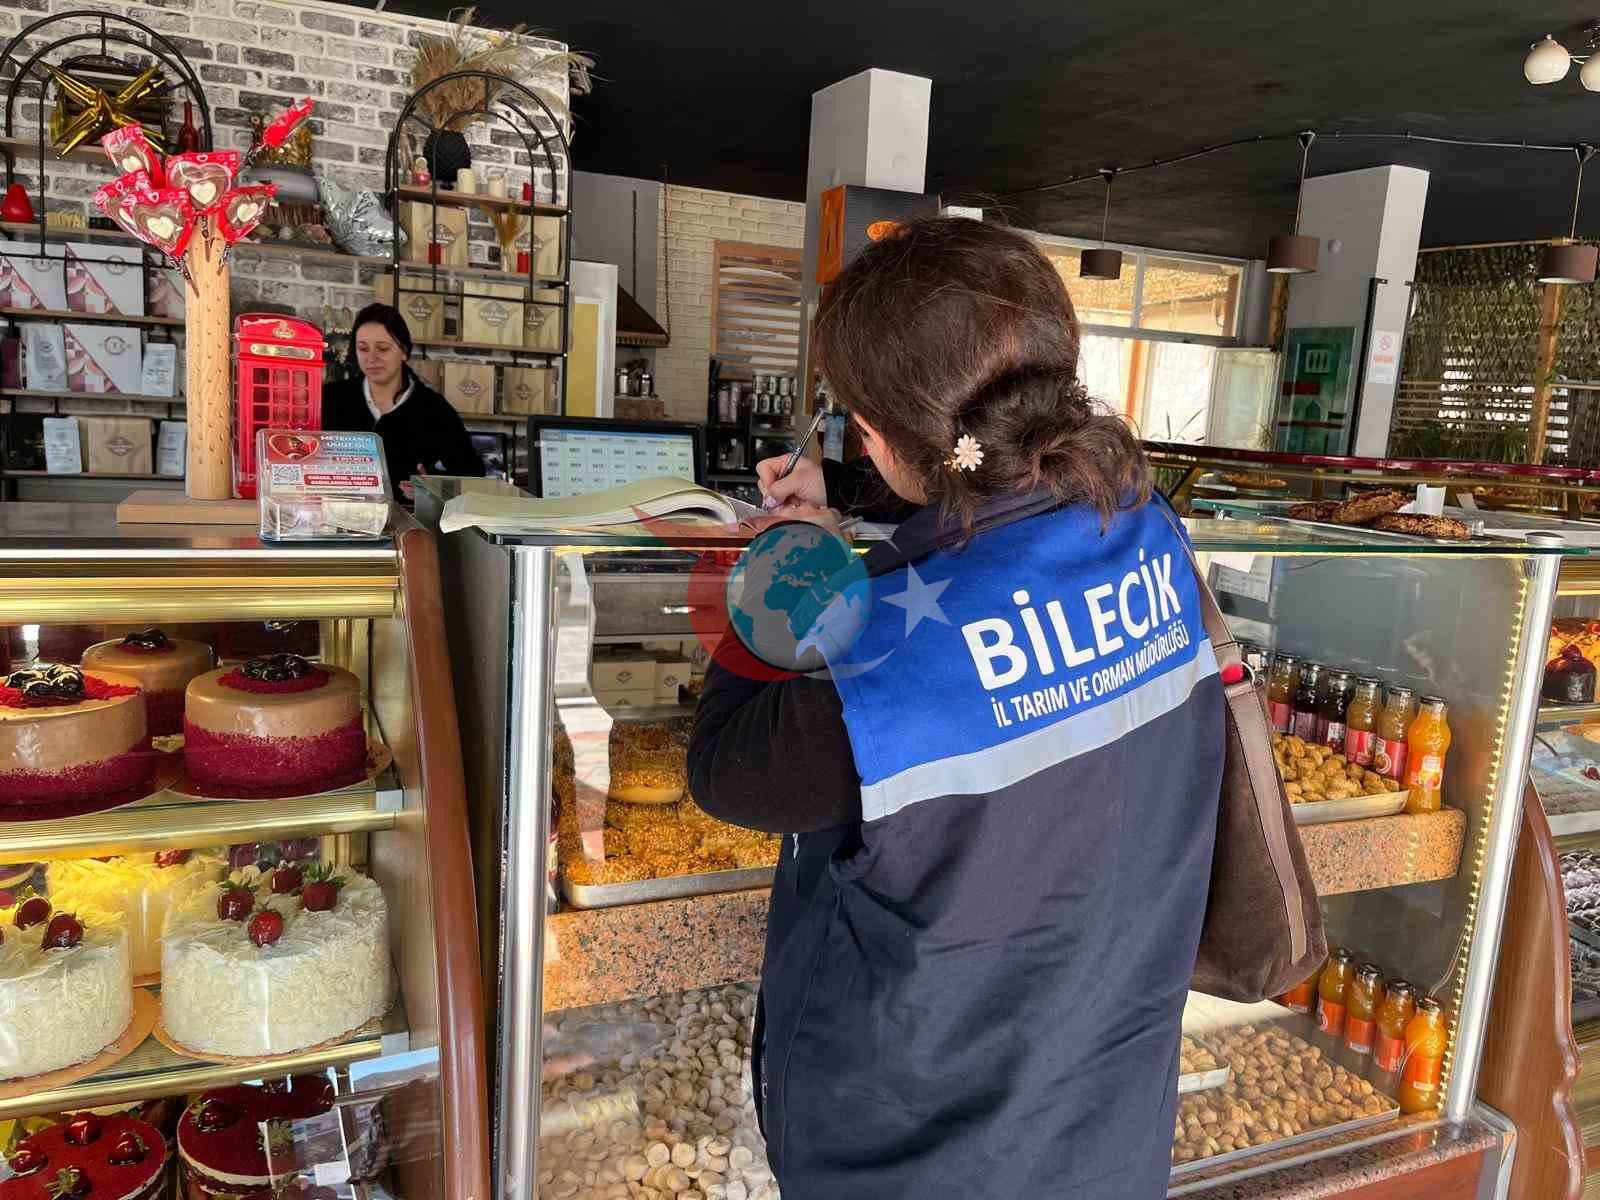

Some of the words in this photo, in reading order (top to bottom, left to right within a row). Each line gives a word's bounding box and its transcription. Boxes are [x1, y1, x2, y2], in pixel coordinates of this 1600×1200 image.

[961, 548, 1182, 691] BİLECİK
[991, 697, 1012, 728] İL
[1010, 687, 1069, 721] TARIM
[1069, 677, 1092, 705] VE
[1092, 664, 1136, 697] ORMAN
[1135, 619, 1190, 674] MÜDÜRLÜĞÜ
